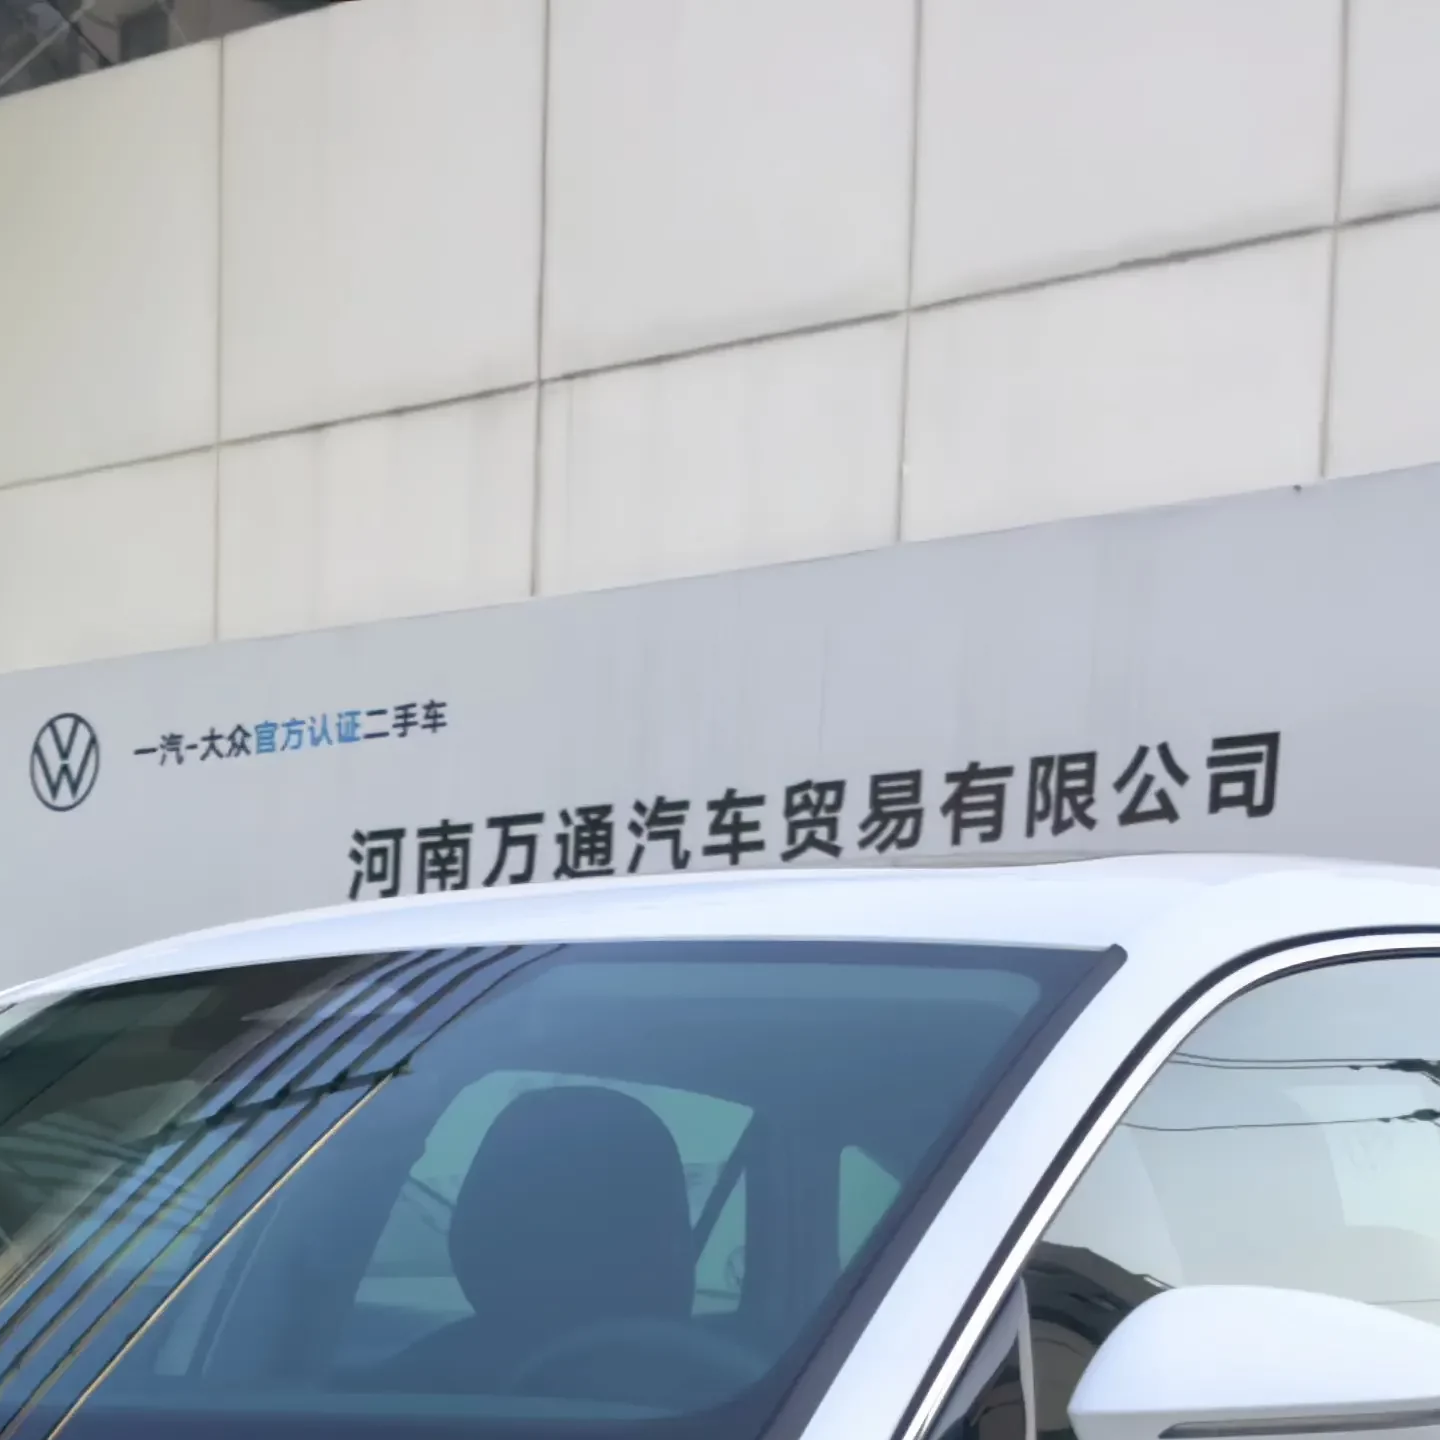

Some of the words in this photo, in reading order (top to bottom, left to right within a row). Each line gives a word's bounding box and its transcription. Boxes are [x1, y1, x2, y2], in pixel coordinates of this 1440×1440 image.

[133, 699, 448, 766] 一汽-大众官方认证二手车
[348, 731, 1281, 900] 河南万通汽车贸易有限公司
